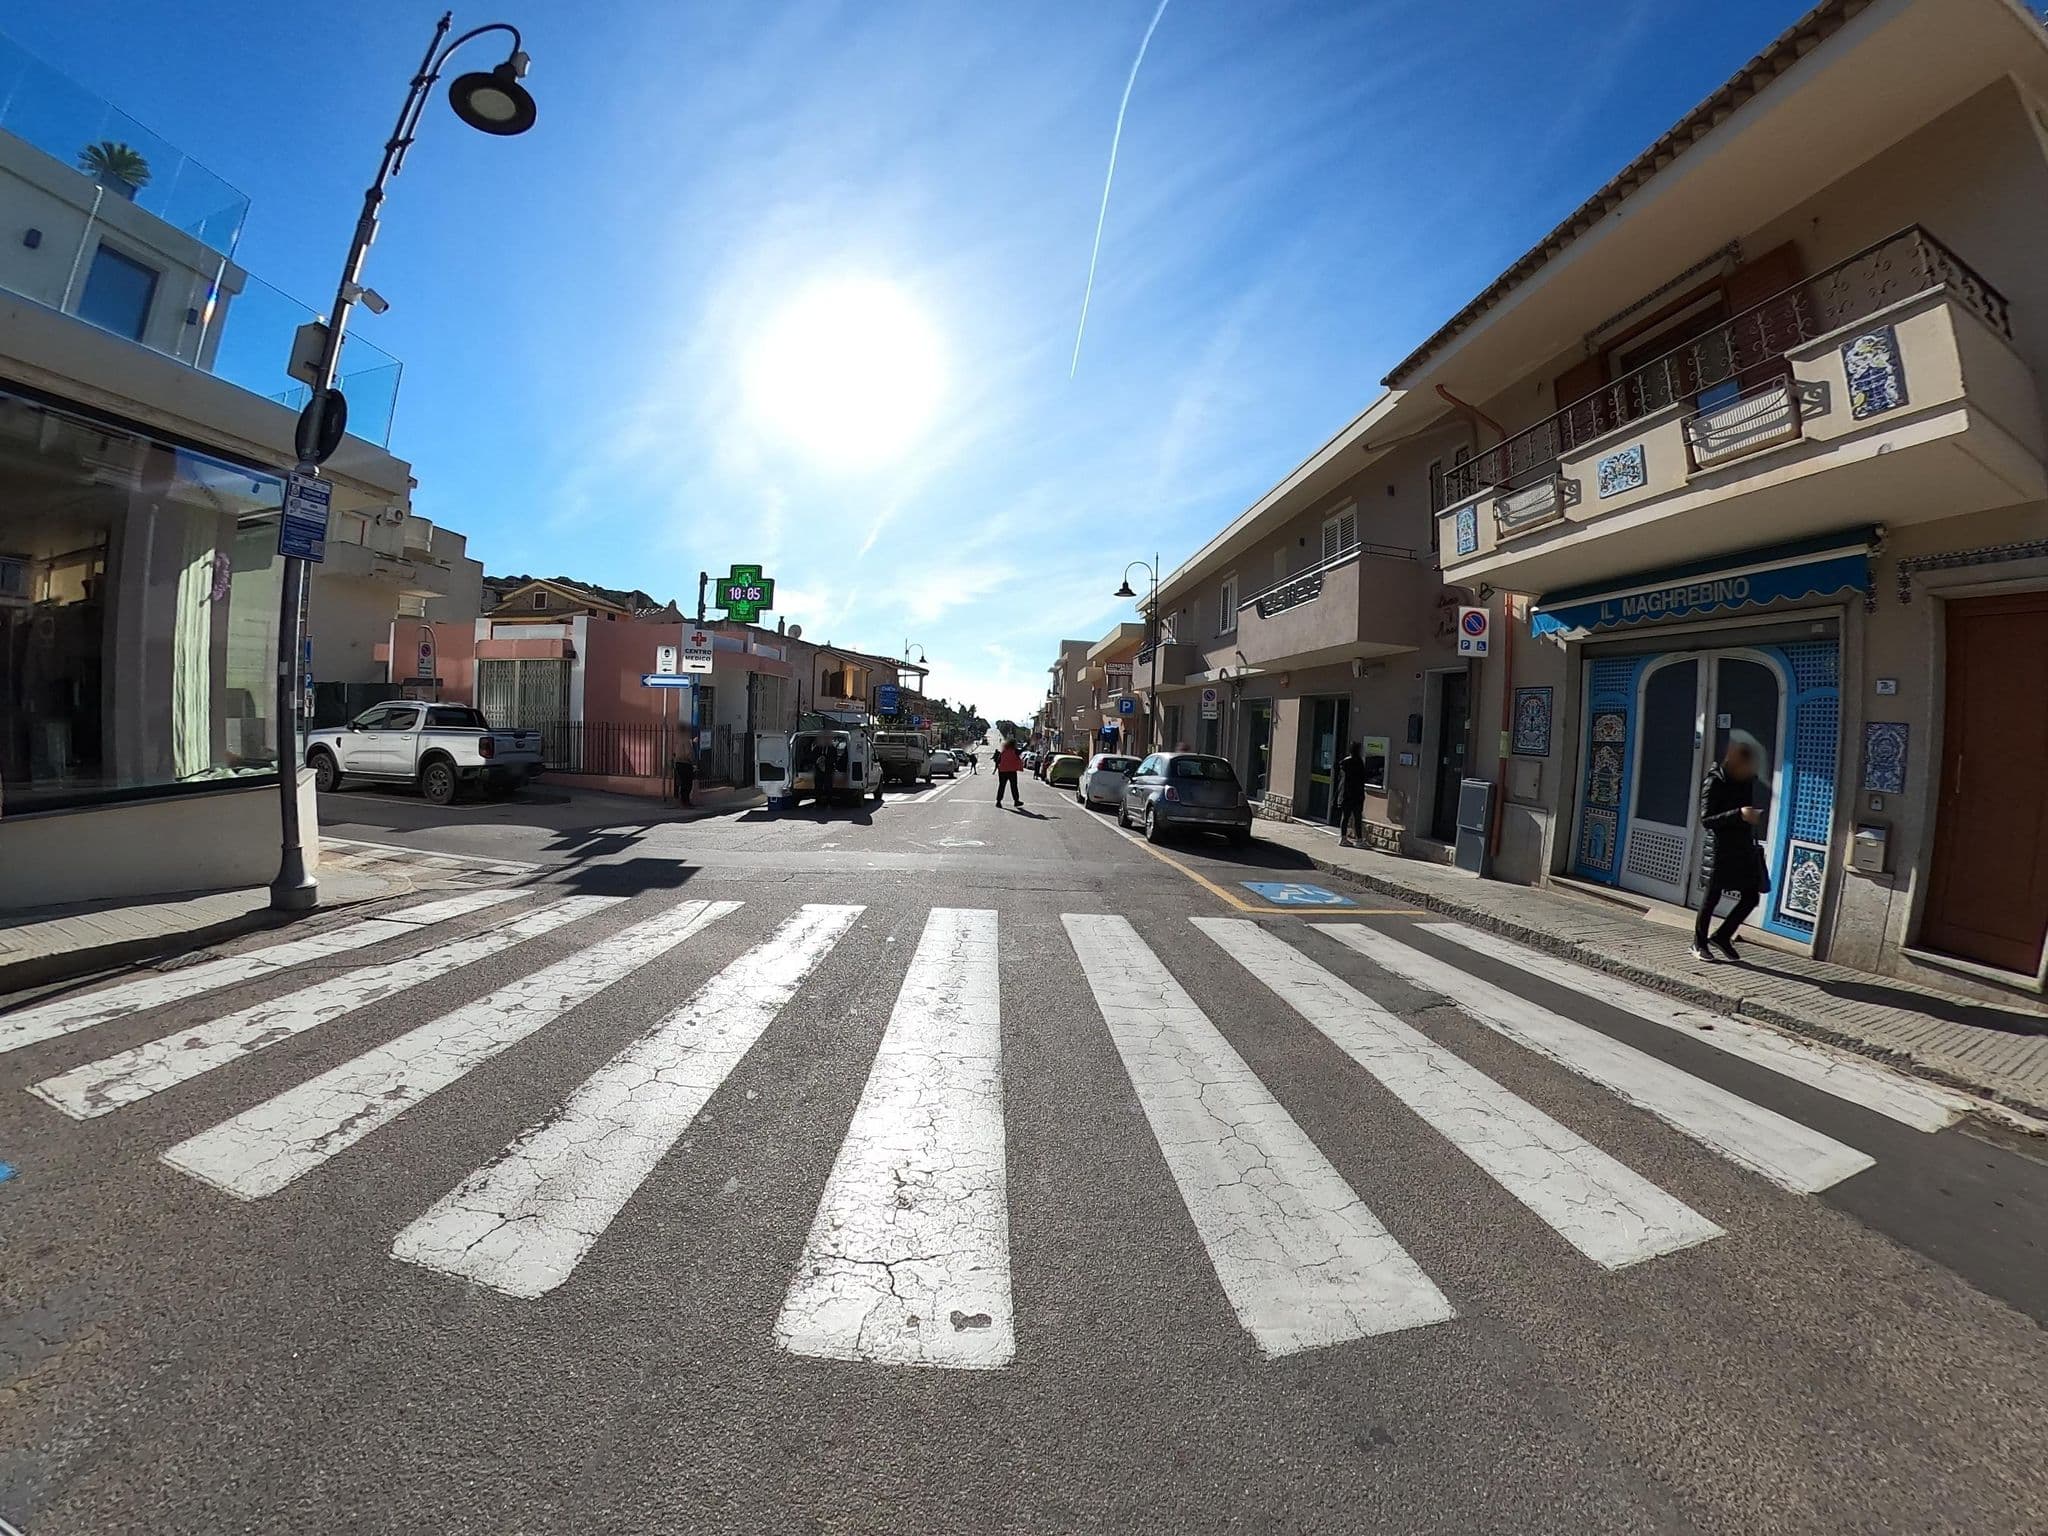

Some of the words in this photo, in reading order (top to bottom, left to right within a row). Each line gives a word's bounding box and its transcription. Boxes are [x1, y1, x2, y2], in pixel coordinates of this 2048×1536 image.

[729, 587, 760, 600] 10:05
[1600, 602, 1614, 620] IL
[1622, 577, 1750, 617] MAGHREBINO
[1462, 640, 1469, 649] P
[685, 648, 712, 656] CENTRO
[1122, 701, 1131, 712] P
